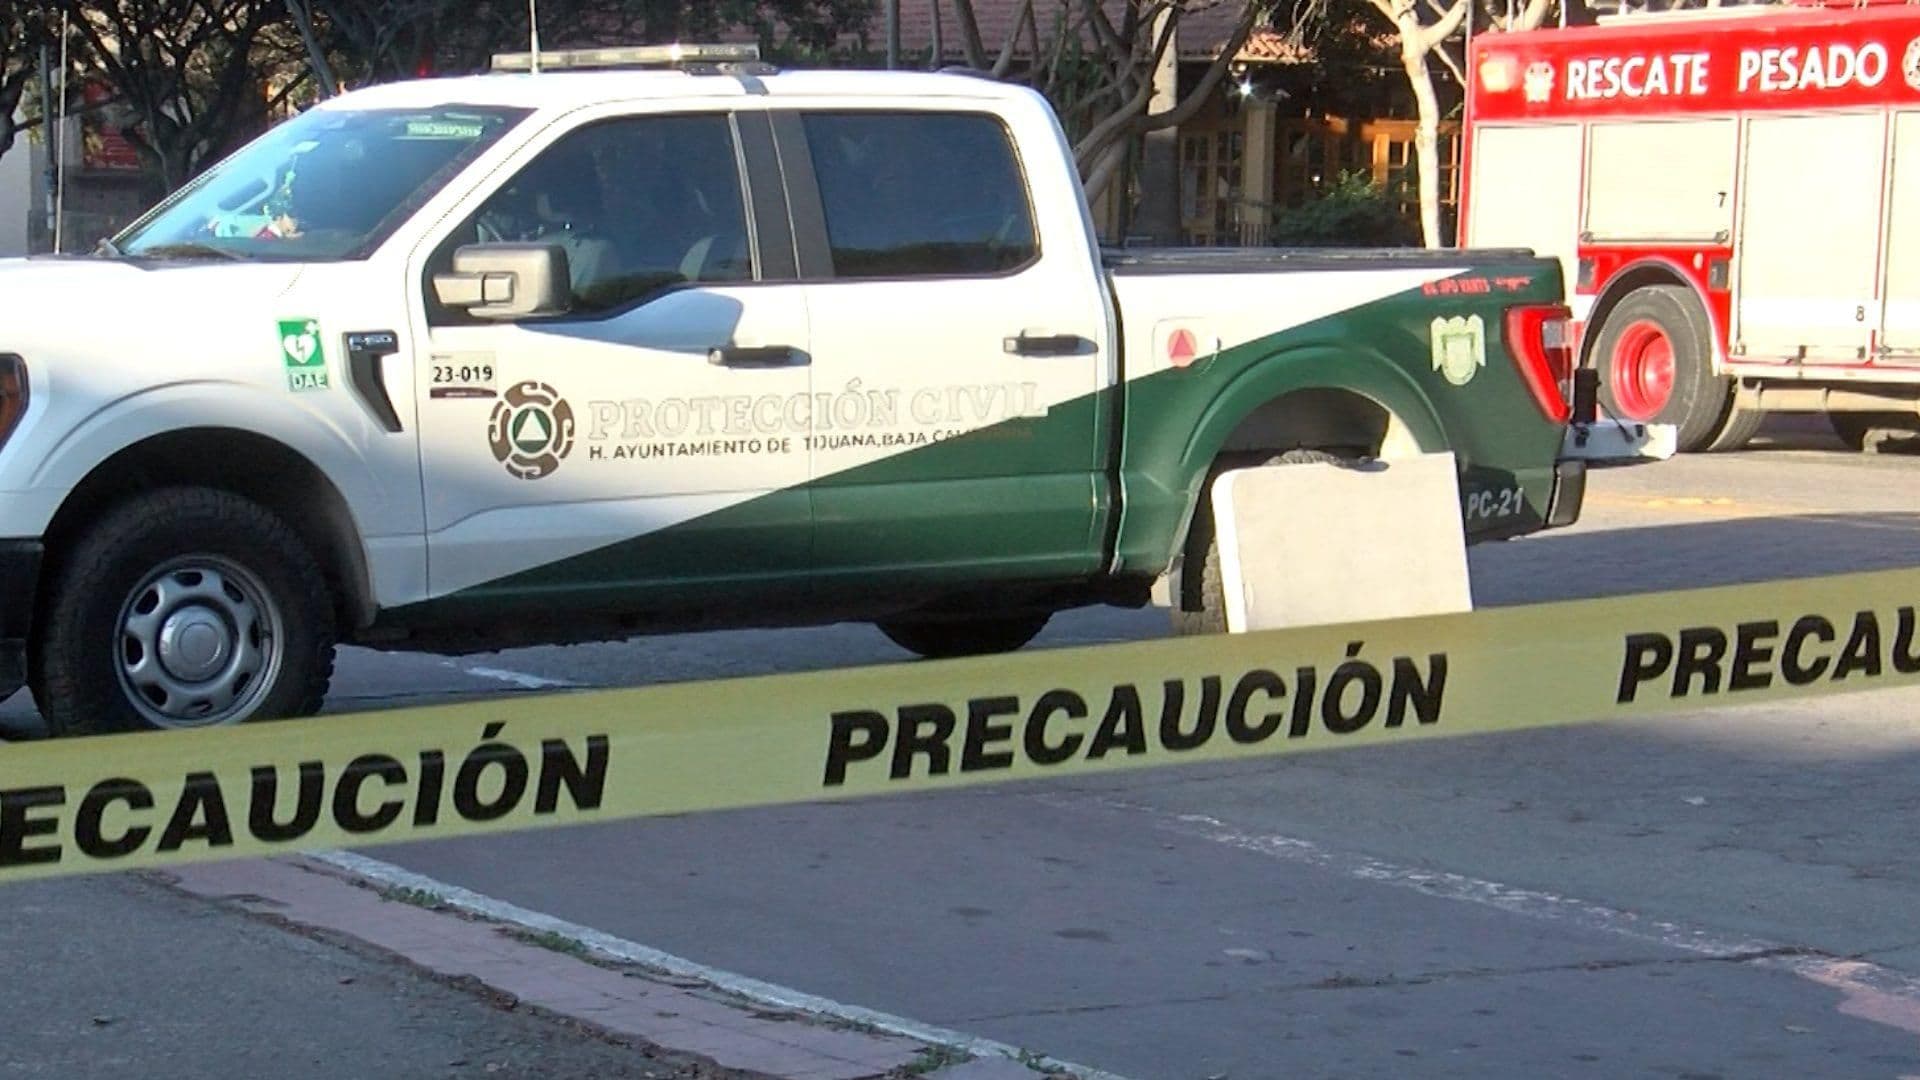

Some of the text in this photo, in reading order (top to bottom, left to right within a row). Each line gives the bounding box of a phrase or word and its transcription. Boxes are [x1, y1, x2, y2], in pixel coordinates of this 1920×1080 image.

[1565, 52, 1711, 100] RESCATE
[1737, 42, 1888, 94] PESADO
[1717, 191, 1728, 208] 7
[1855, 305, 1865, 322] 8
[292, 373, 328, 390] DAE
[432, 365, 493, 383] 23-019
[587, 377, 1049, 441] PROTECCIÓN CIVIL
[590, 445, 609, 459] H.
[613, 437, 761, 459] AYUNTAMIENTO
[767, 437, 791, 453] DE
[1467, 487, 1524, 520] PC-21
[823, 642, 1448, 788] PRECAUCIÓN
